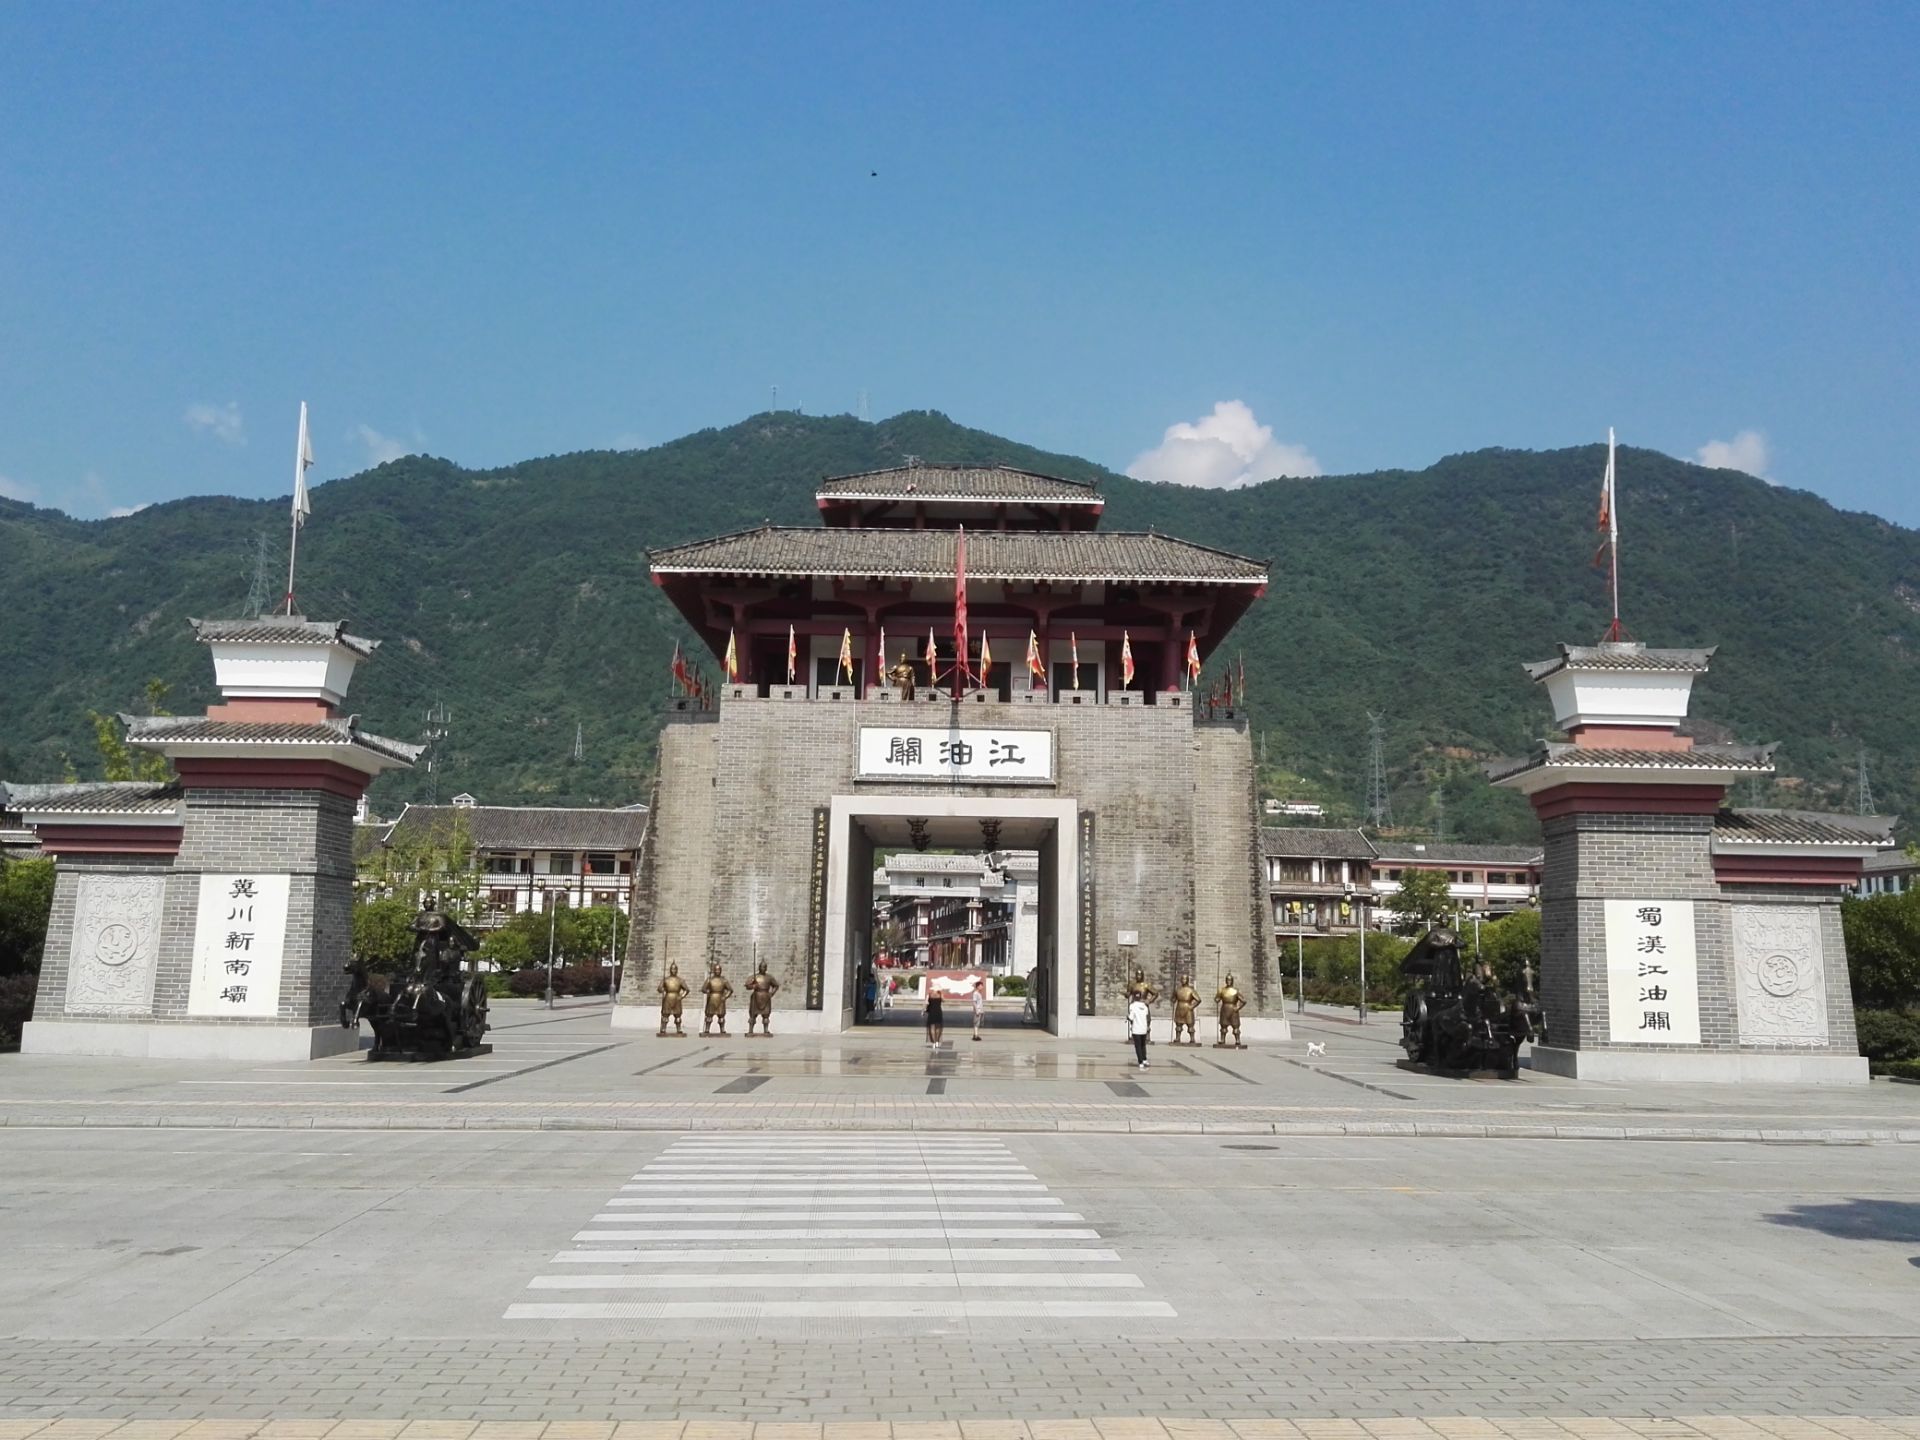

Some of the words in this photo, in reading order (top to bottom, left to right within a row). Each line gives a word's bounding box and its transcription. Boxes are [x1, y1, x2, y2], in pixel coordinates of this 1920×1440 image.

[1635, 906, 1672, 1032] 蜀漢江油關
